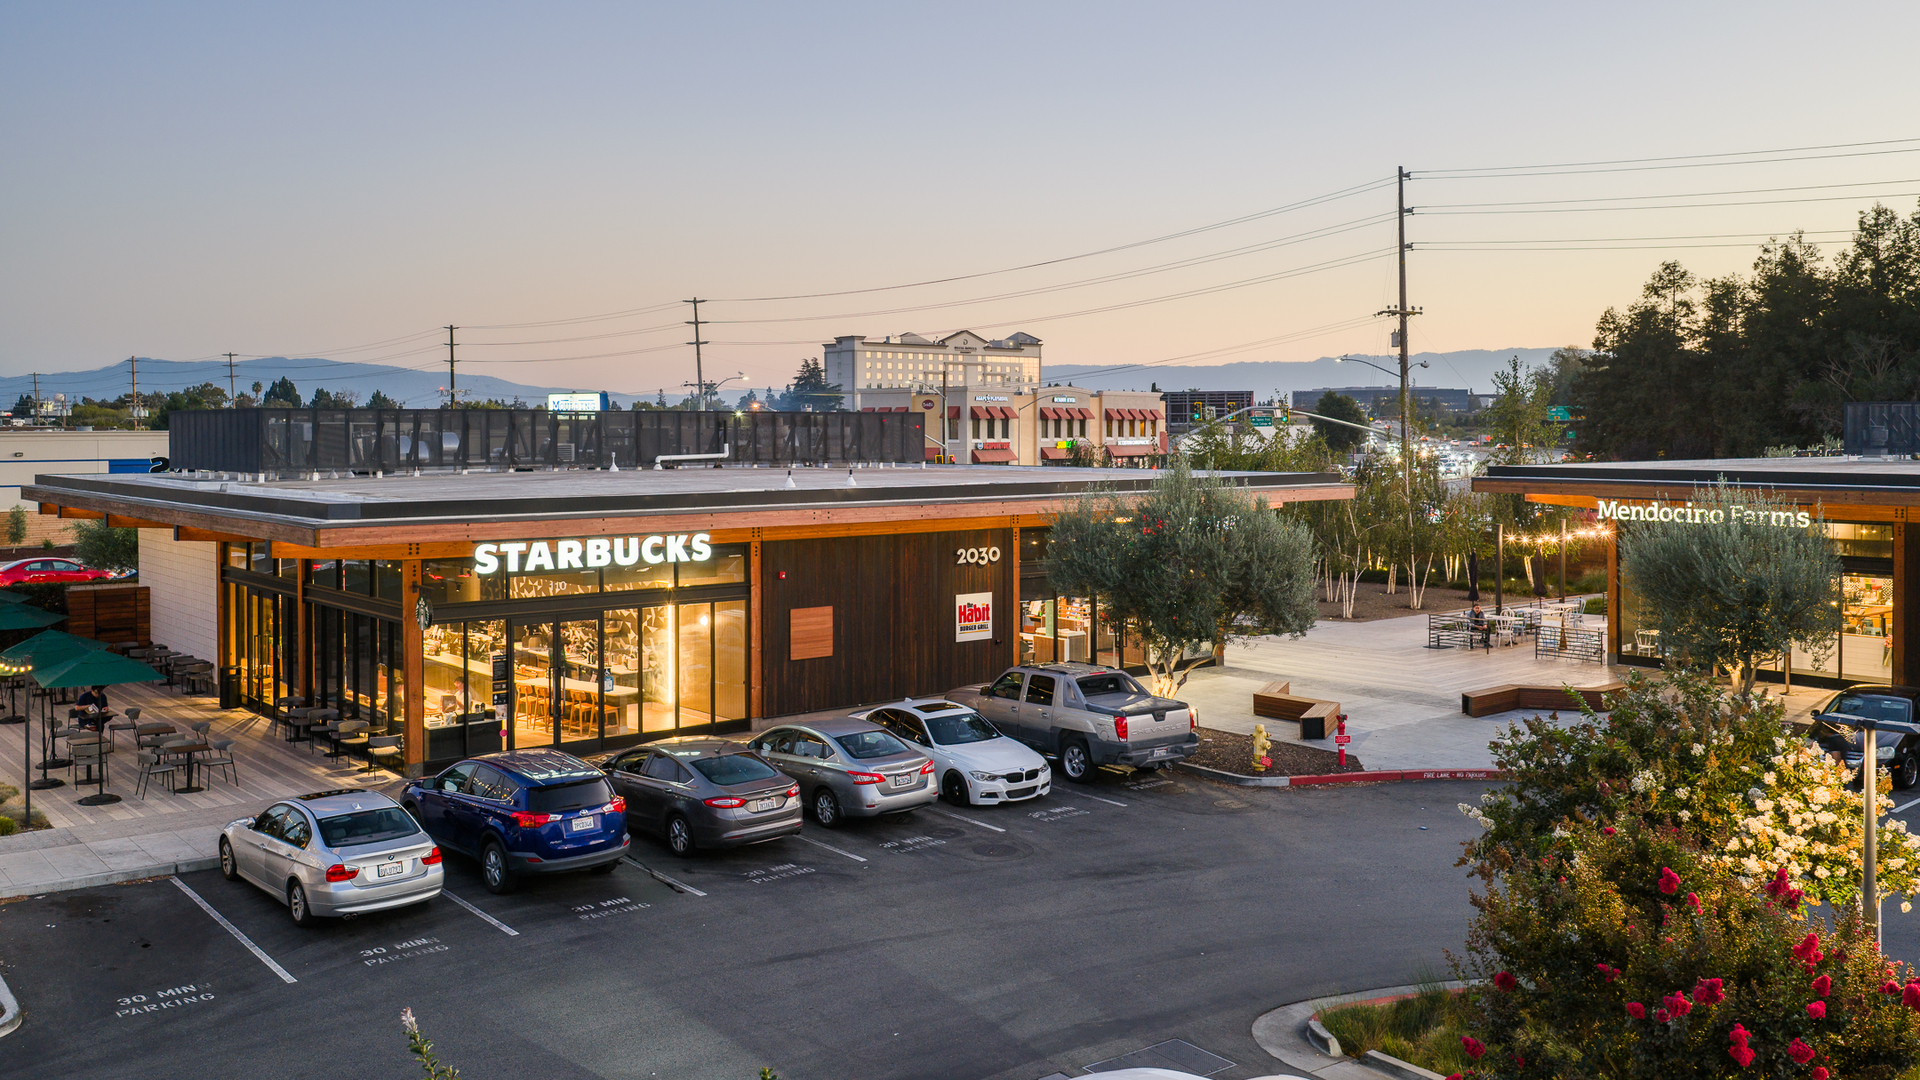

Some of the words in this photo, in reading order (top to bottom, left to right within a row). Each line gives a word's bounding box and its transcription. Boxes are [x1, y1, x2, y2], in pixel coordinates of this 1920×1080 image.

[1596, 500, 1725, 524] Mendocino
[1729, 504, 1811, 529] Farms
[473, 532, 713, 575] STARBUCKS
[956, 546, 1001, 566] 2030
[958, 603, 990, 624] Habit
[1130, 721, 1188, 736] CHEVROLET
[750, 867, 816, 885] PARKING
[571, 904, 595, 913] 30
[599, 896, 631, 907] MIN
[579, 902, 651, 921] PARKING
[360, 946, 387, 957] 30
[394, 938, 428, 950] MIN
[363, 944, 450, 967] PARKING
[115, 992, 215, 1018] PARKING
[116, 994, 148, 1006] 30
[156, 984, 197, 998] MIN
